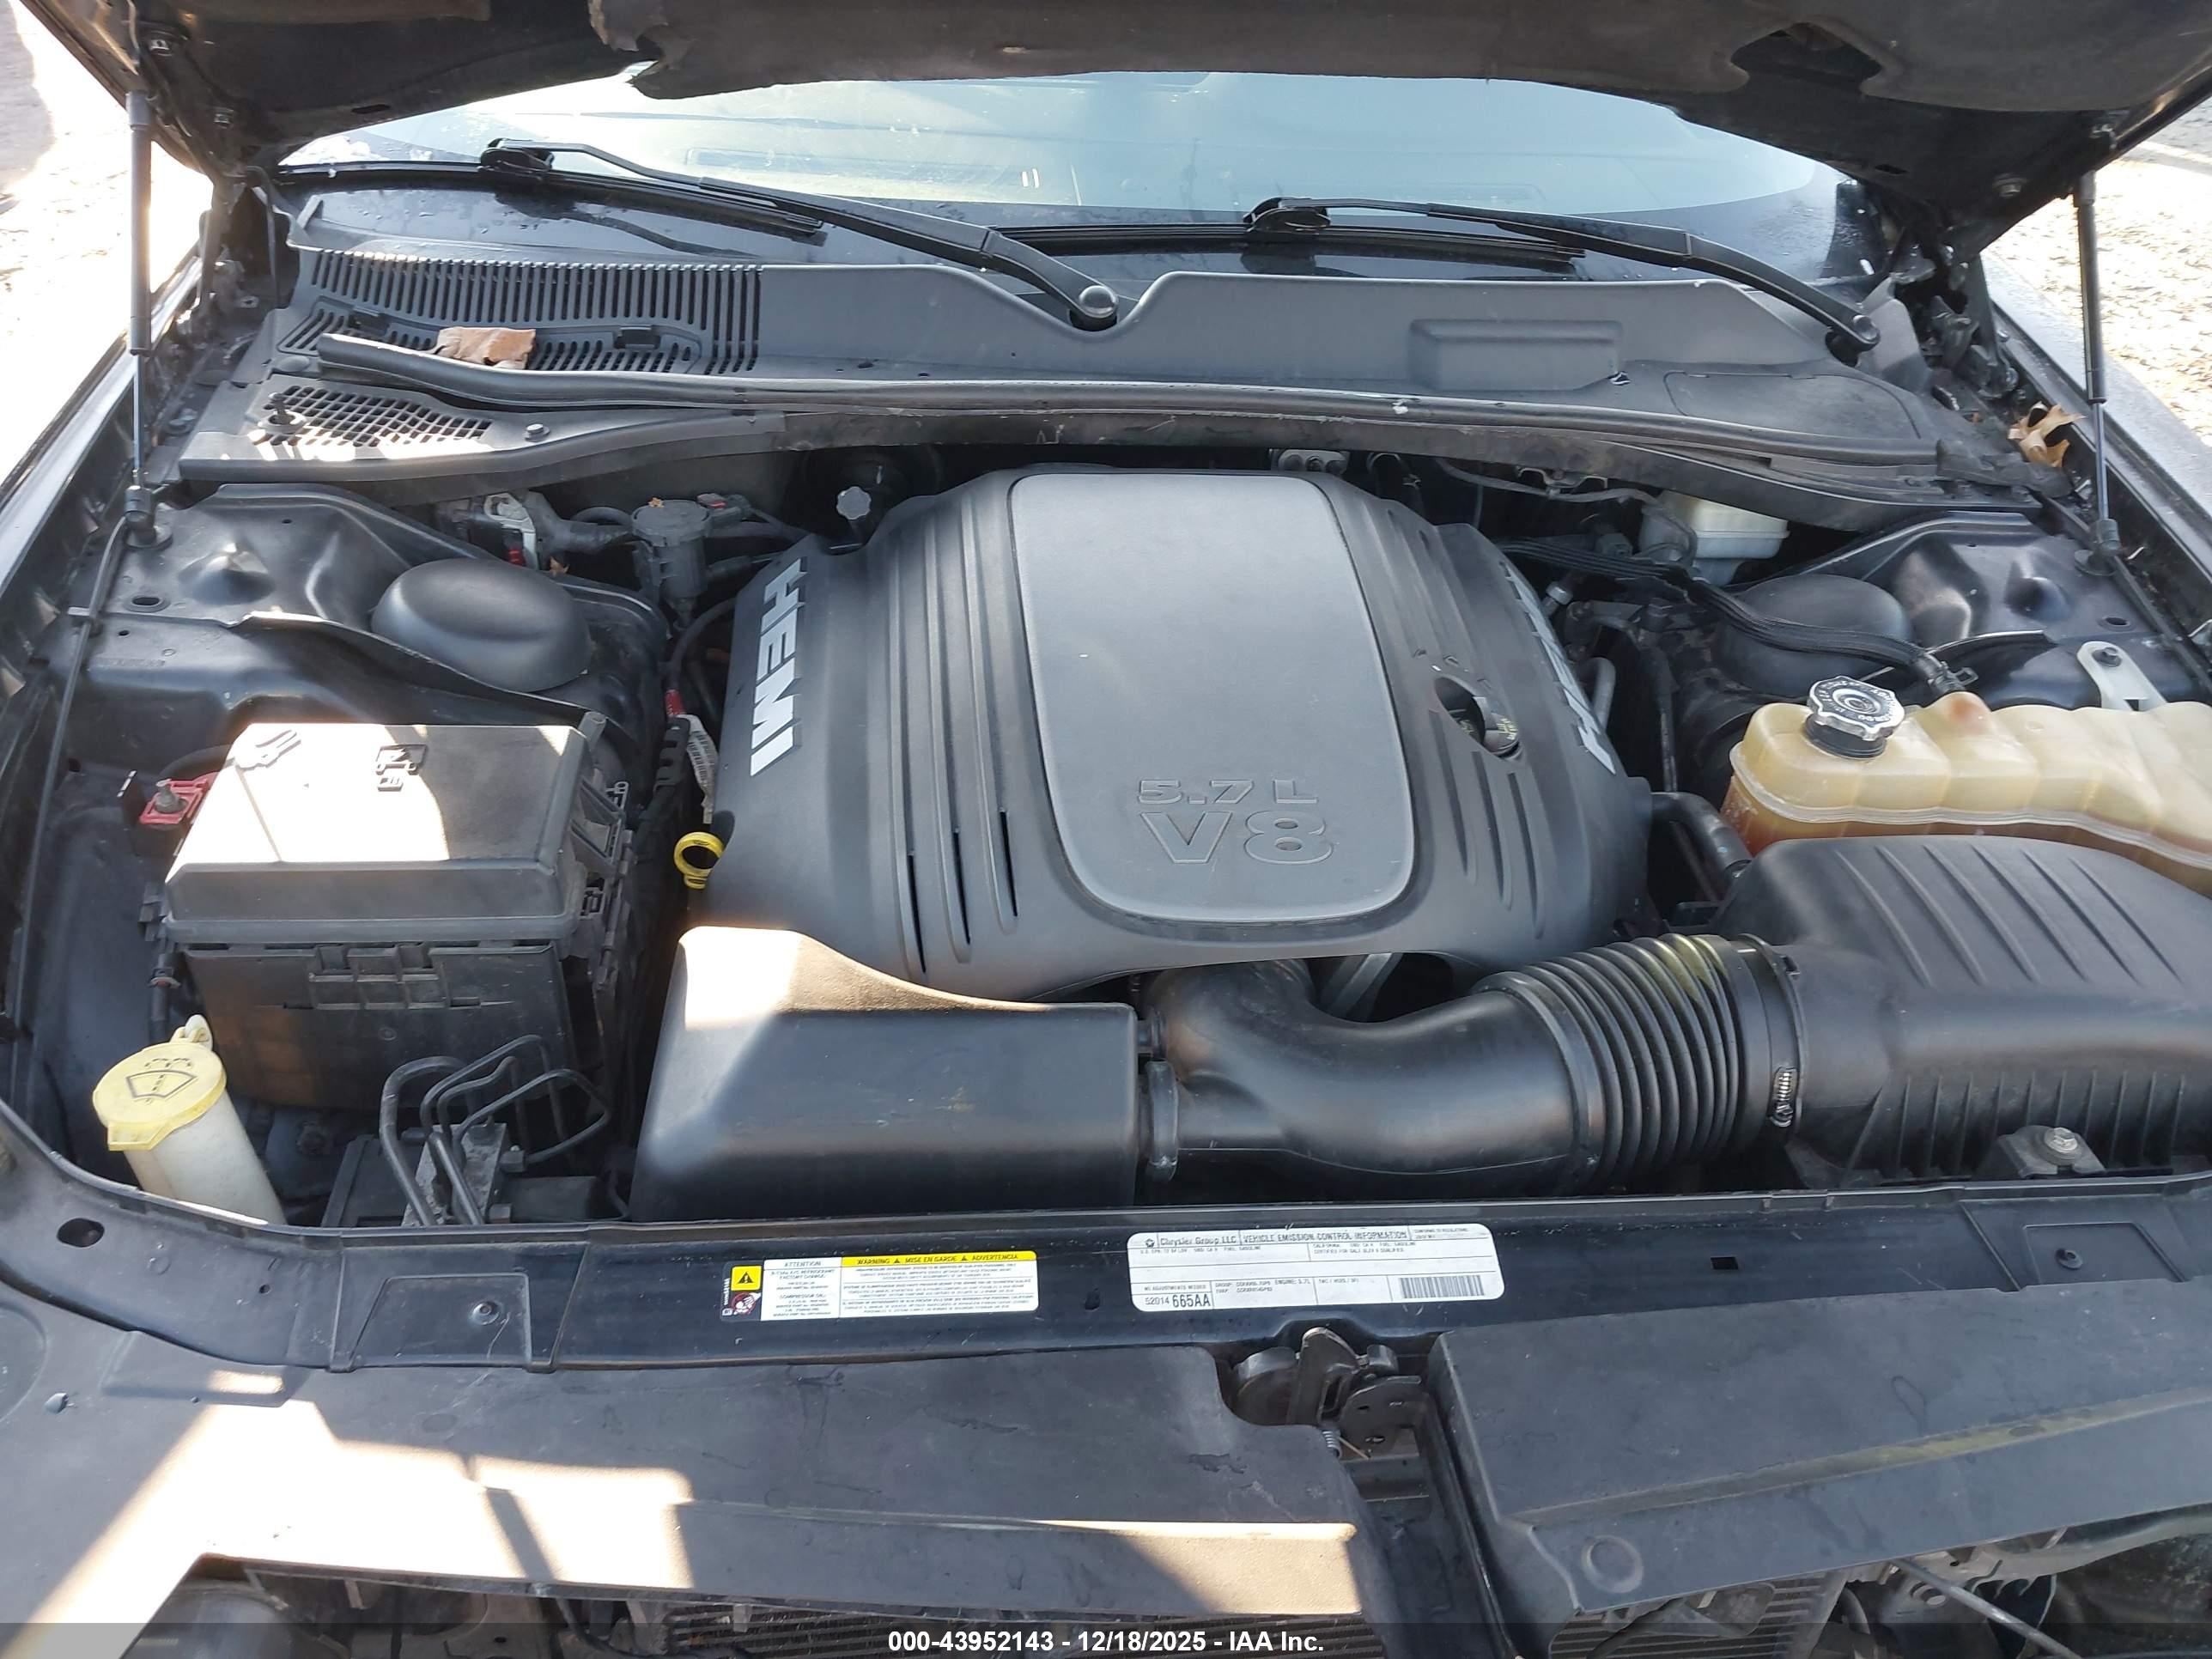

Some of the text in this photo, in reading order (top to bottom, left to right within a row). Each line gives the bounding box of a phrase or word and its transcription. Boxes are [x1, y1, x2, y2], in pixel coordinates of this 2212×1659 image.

[750, 558, 802, 777] HEMI
[1139, 810, 1333, 866] V8
[1160, 1236, 1237, 1247] Chrysler Group LLC
[1244, 1234, 1275, 1243] VEHICLE
[1277, 1232, 1315, 1242] EMISSION
[1317, 1232, 1351, 1241] CONTROL
[1353, 1231, 1408, 1240] INFORMATION
[1172, 1293, 1211, 1308] 665AA
